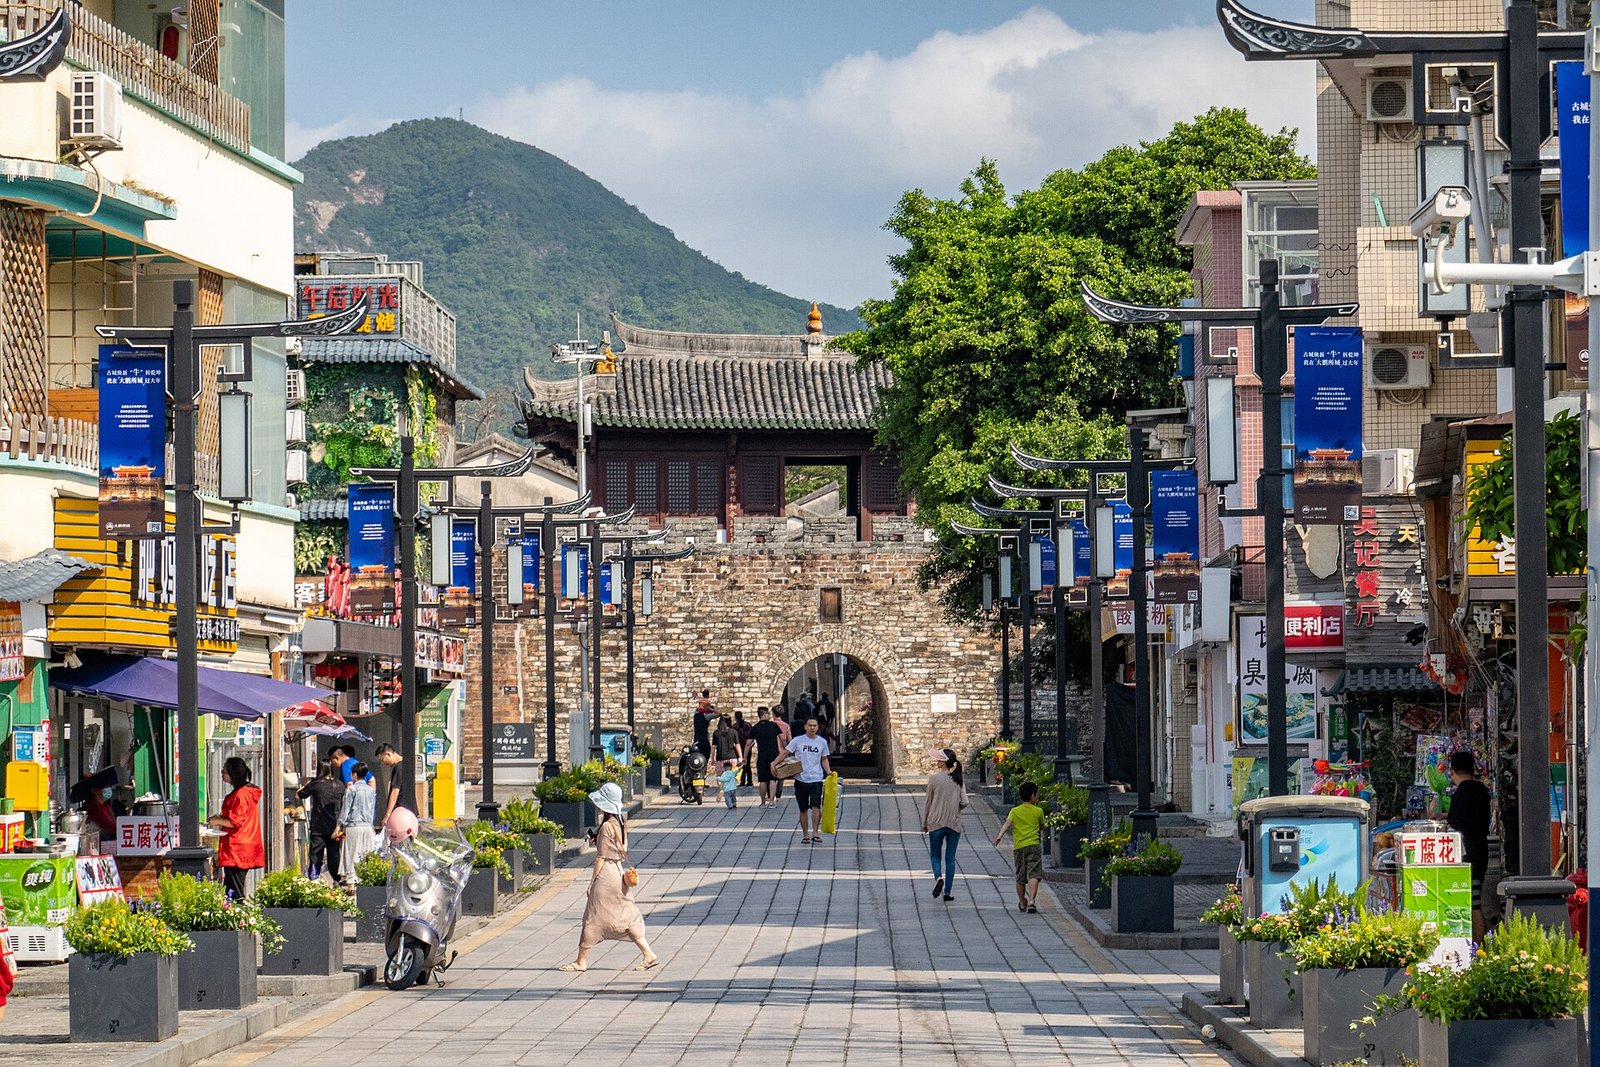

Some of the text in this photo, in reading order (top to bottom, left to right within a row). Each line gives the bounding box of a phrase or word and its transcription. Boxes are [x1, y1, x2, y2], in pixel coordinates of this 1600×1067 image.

[1572, 101, 1590, 111] 古城
[1353, 507, 1381, 629] 吴记餐厅
[1116, 603, 1165, 626] 酸粉
[1284, 616, 1341, 637] 便利店
[121, 822, 169, 849] 豆腐花
